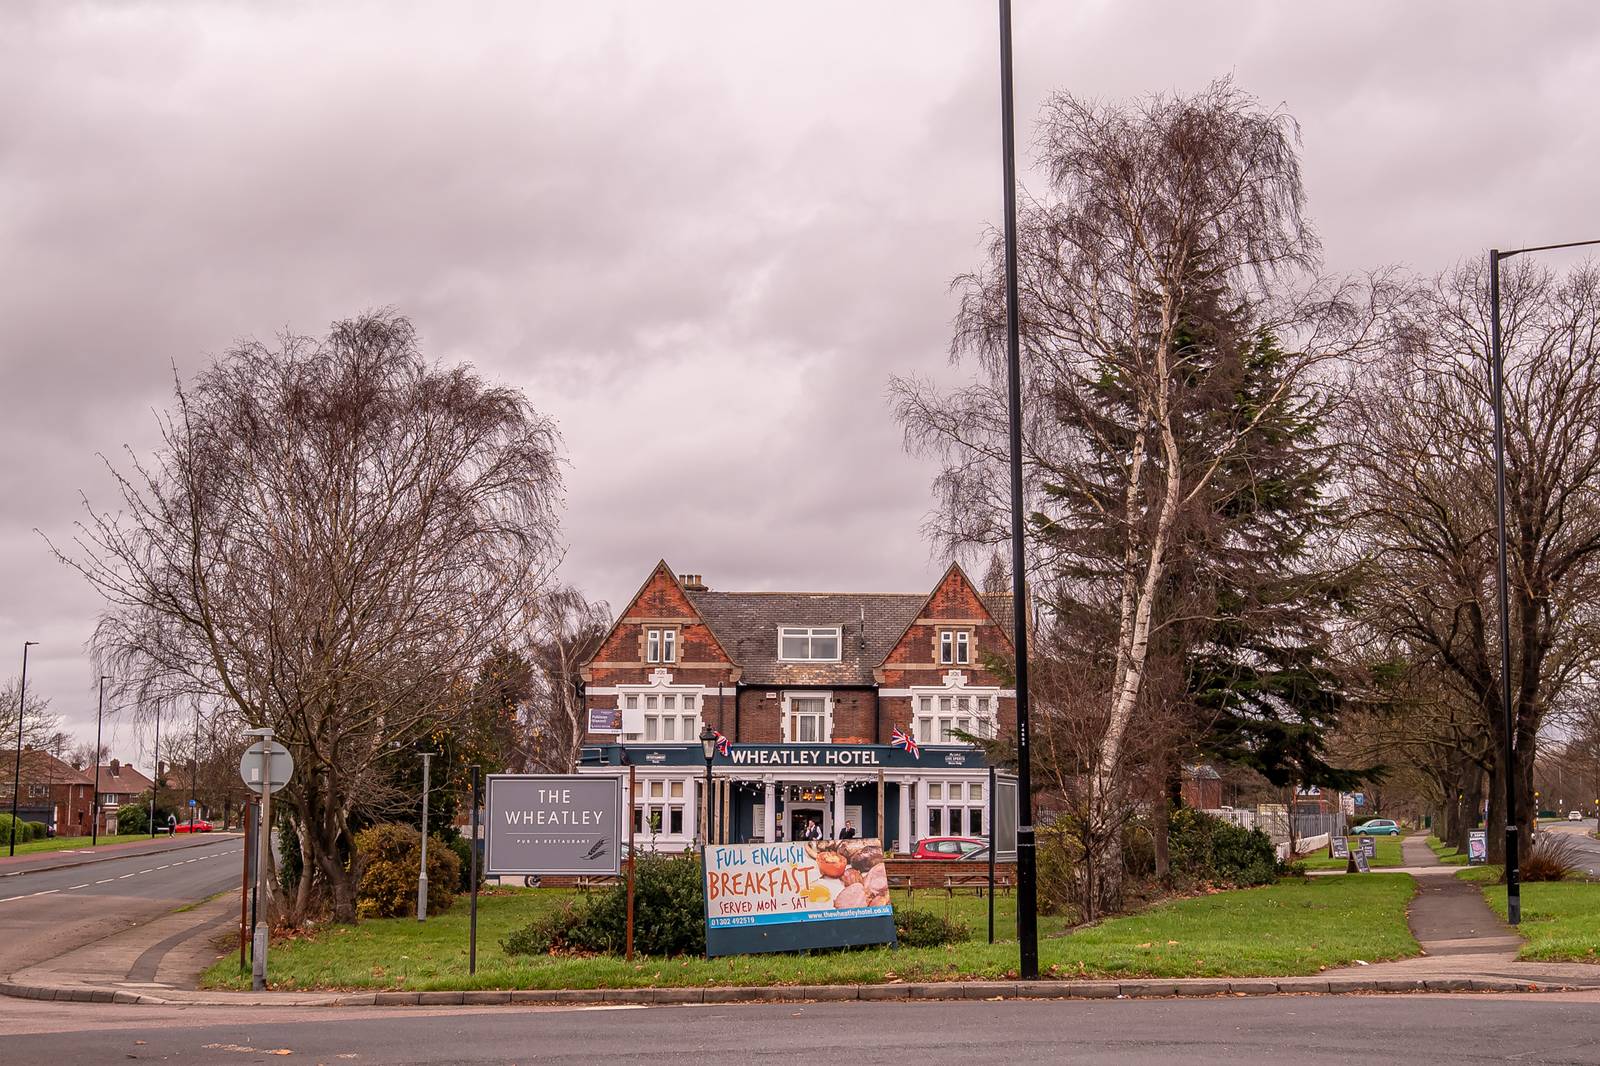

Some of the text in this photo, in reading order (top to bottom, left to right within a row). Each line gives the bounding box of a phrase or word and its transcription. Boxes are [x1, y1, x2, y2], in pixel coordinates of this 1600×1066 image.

[731, 750, 880, 764] WHEATLEY HOTEL
[538, 789, 571, 804] THE
[505, 810, 603, 825] WHEATLEY
[716, 845, 804, 869] FULL ENGLISH
[708, 866, 815, 900] BREAKFAST
[720, 901, 752, 915] SERVED
[757, 899, 777, 912] MON
[792, 896, 809, 910] SAT
[808, 907, 890, 919] www.thewheatleyhotel.co.uk
[711, 916, 755, 926] 01302 492519
